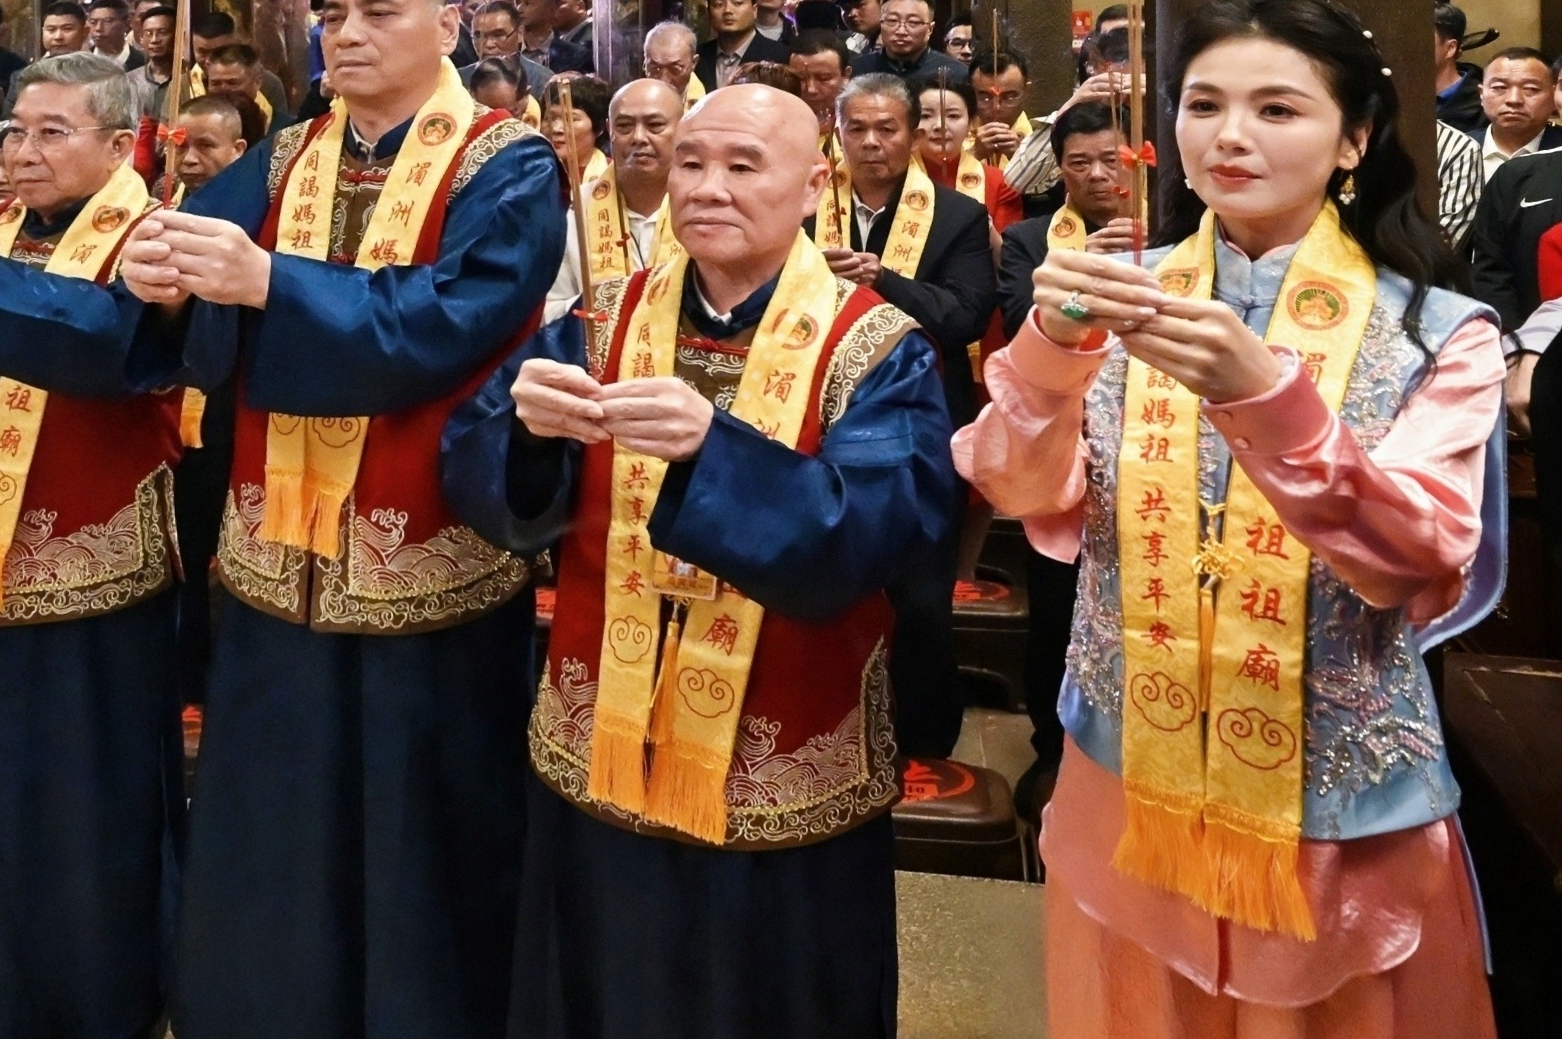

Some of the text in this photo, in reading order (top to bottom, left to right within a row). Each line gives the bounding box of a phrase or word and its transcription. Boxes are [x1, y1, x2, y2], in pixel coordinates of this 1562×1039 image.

[291, 150, 320, 251] 同謁媽祖
[369, 162, 429, 265] 湄洲媽
[69, 242, 98, 264] 湄
[620, 461, 651, 598] 共享平安
[1236, 517, 1290, 692] 祖祖廟
